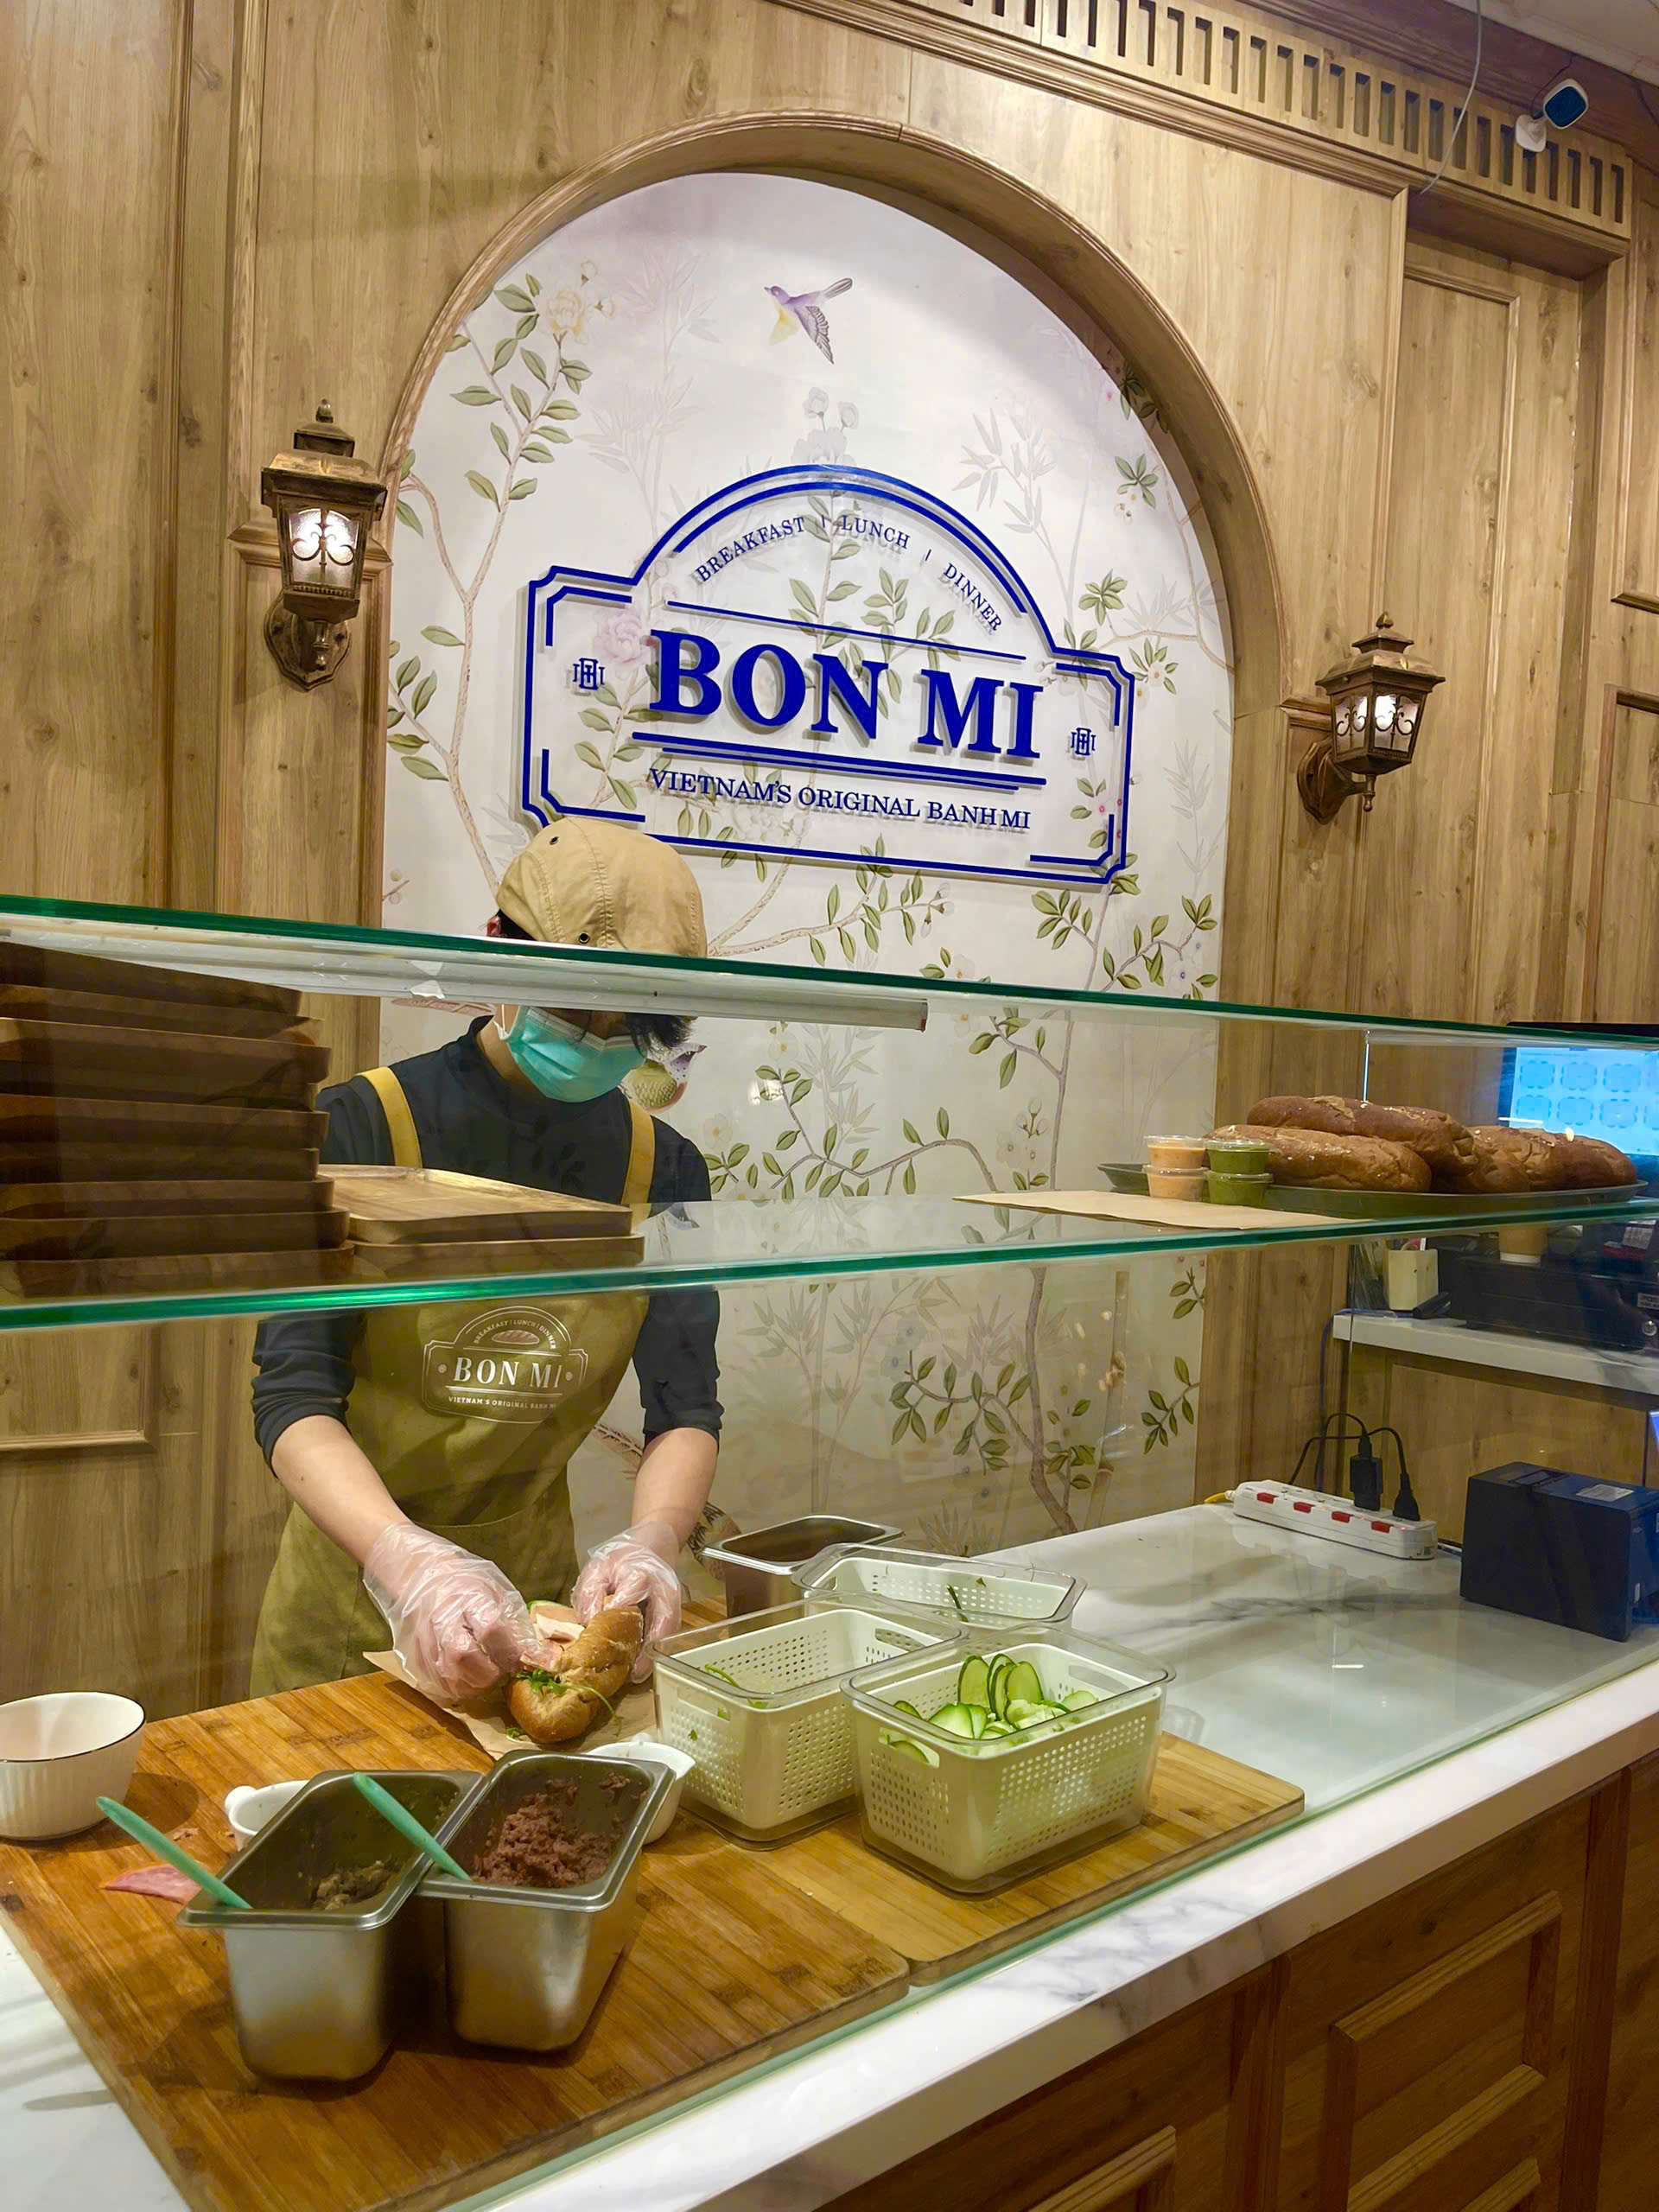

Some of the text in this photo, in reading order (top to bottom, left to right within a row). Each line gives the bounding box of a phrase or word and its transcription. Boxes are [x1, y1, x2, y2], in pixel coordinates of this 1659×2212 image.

[694, 514, 1003, 632] BREAKFAST LUNCH DINNER
[649, 628, 1044, 759] BON MI
[649, 767, 1032, 830] VIETNAM'S ORIGINAL BANH MI
[473, 1319, 557, 1349] BREAKFAST LUNCH DINNER
[453, 1357, 563, 1389] BON MI
[448, 1395, 490, 1405] VIETNAM'S
[491, 1399, 528, 1409] ORIGINAL
